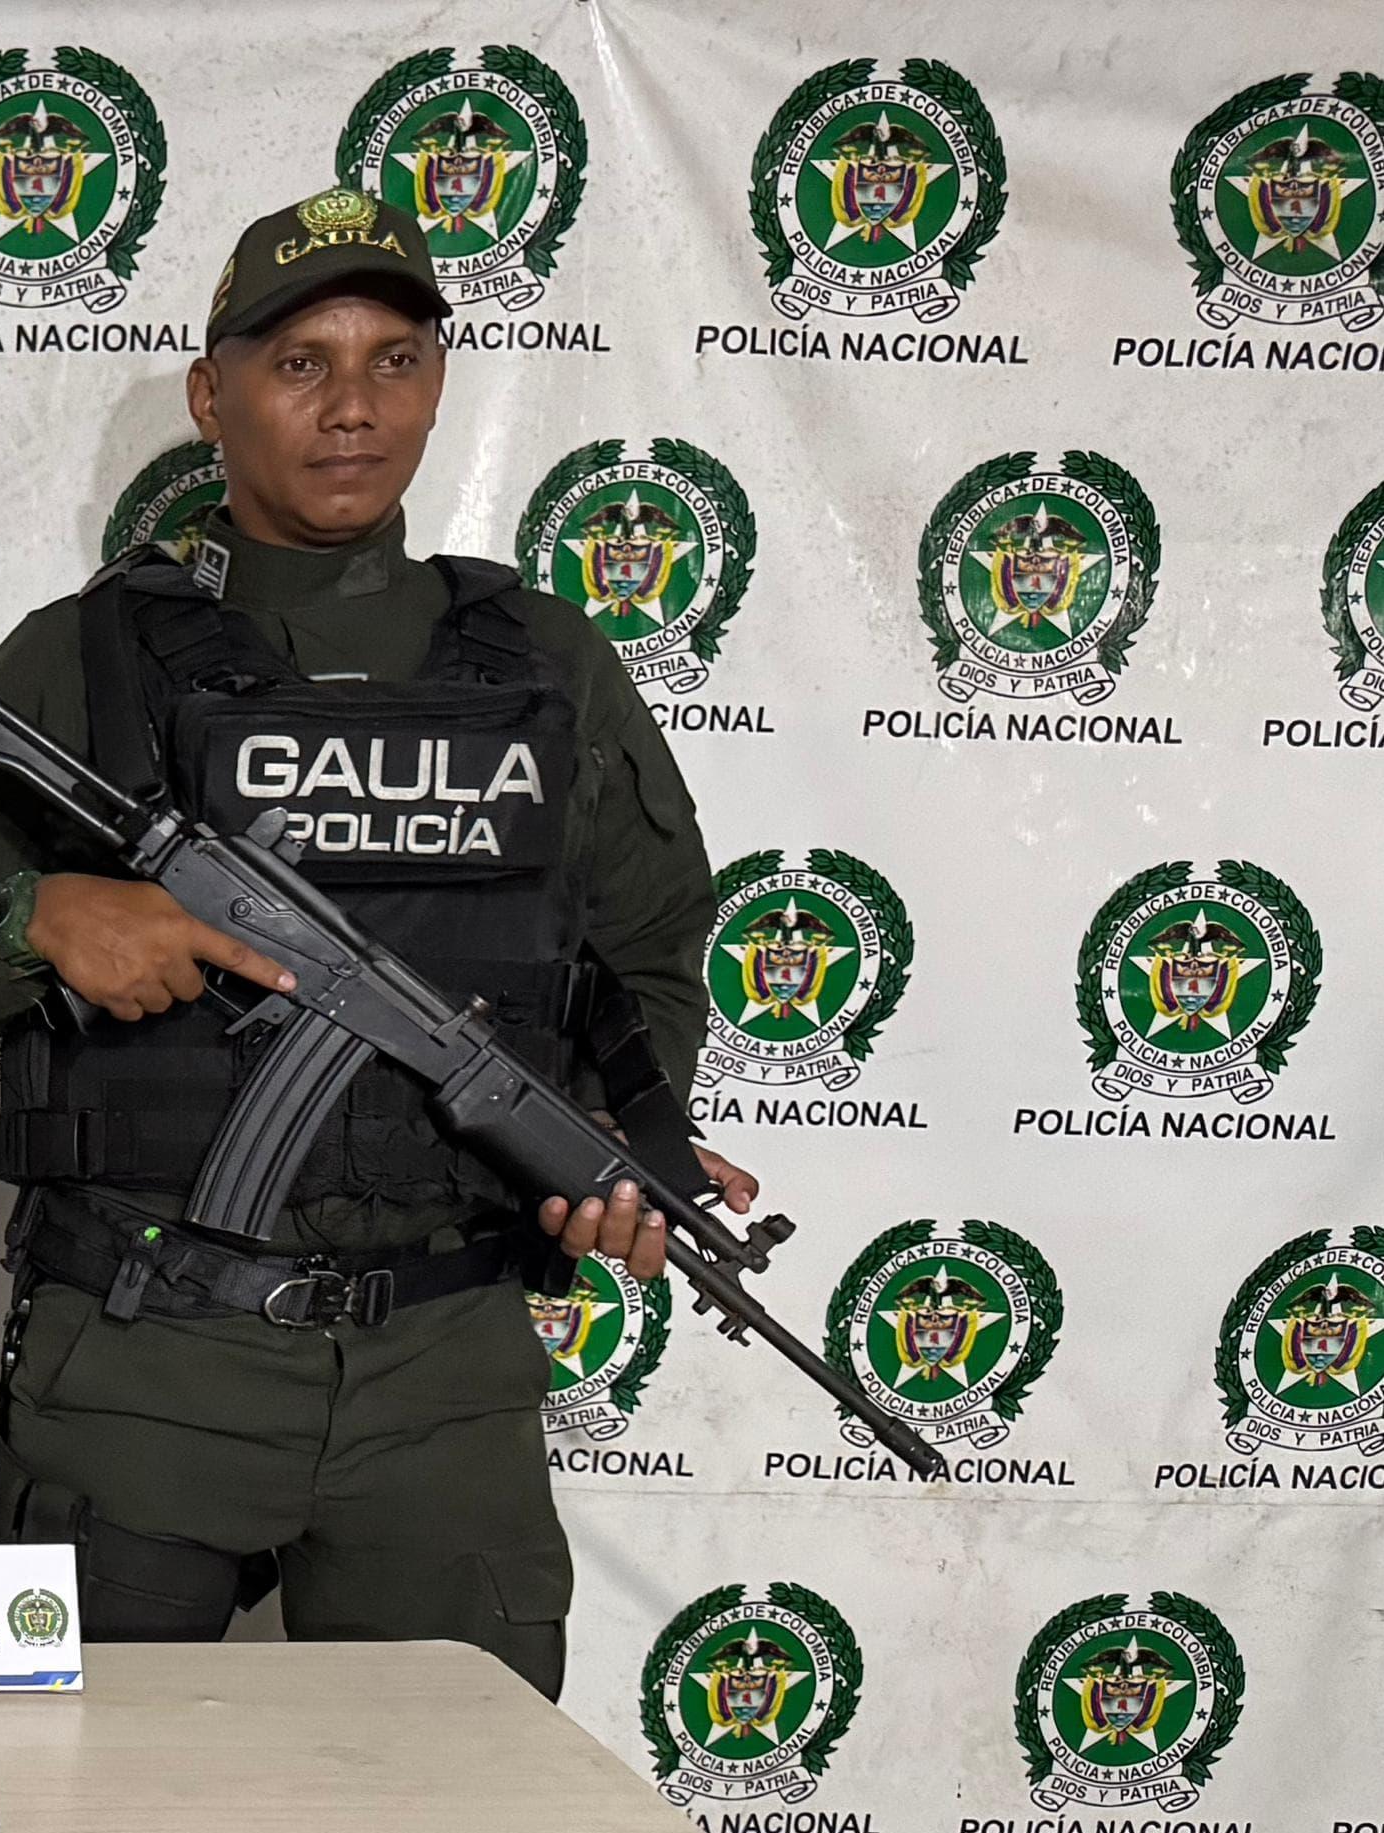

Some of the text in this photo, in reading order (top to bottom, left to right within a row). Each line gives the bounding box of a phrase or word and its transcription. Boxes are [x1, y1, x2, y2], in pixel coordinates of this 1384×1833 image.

[28, 75, 53, 89] DE
[72, 82, 134, 166] COLOMBIA
[872, 86, 896, 100] DE
[914, 96, 975, 177] COLOMBIA
[38, 221, 120, 276] NACIONAL
[275, 231, 407, 265] GAULA
[789, 229, 961, 285] POLICIA NACIONAL
[17, 287, 27, 302] Y
[42, 273, 105, 300] PATRIA
[791, 279, 939, 310] DIOS Y PATRIA
[16, 324, 200, 352] NACIONAL
[696, 324, 1028, 364] POLICÍA NACIONAL
[1113, 332, 1384, 371] POLICÍA NACIO
[648, 703, 774, 732] CIONAL
[863, 706, 1182, 744] POLICÍA NACIONAL
[1263, 714, 1384, 748] POLICÍ
[236, 735, 544, 803] GAULA
[286, 805, 501, 856] POLICÍA
[1191, 886, 1215, 899] DE
[1231, 893, 1288, 970] COLOMBIA
[1113, 1019, 1272, 1069] POLICIA NACIONAL
[1114, 1064, 1253, 1092] DIOS Y PATRIA
[756, 1100, 927, 1128] NACIONAL
[1014, 1104, 1335, 1139] POLICÍA NACIONAL
[548, 1448, 693, 1477] ACIONAL
[765, 1450, 896, 1481] POLICÍA
[1155, 1457, 1384, 1489] POLICÍA NACIO
[1125, 1615, 1147, 1627] DE
[1162, 1621, 1212, 1691] COLOMBIA
[1049, 1736, 1197, 1781] POLICIA NACIONAL
[1051, 1777, 1180, 1802] DIOS Y PATRIA
[721, 1812, 879, 1833] NACIONAL
